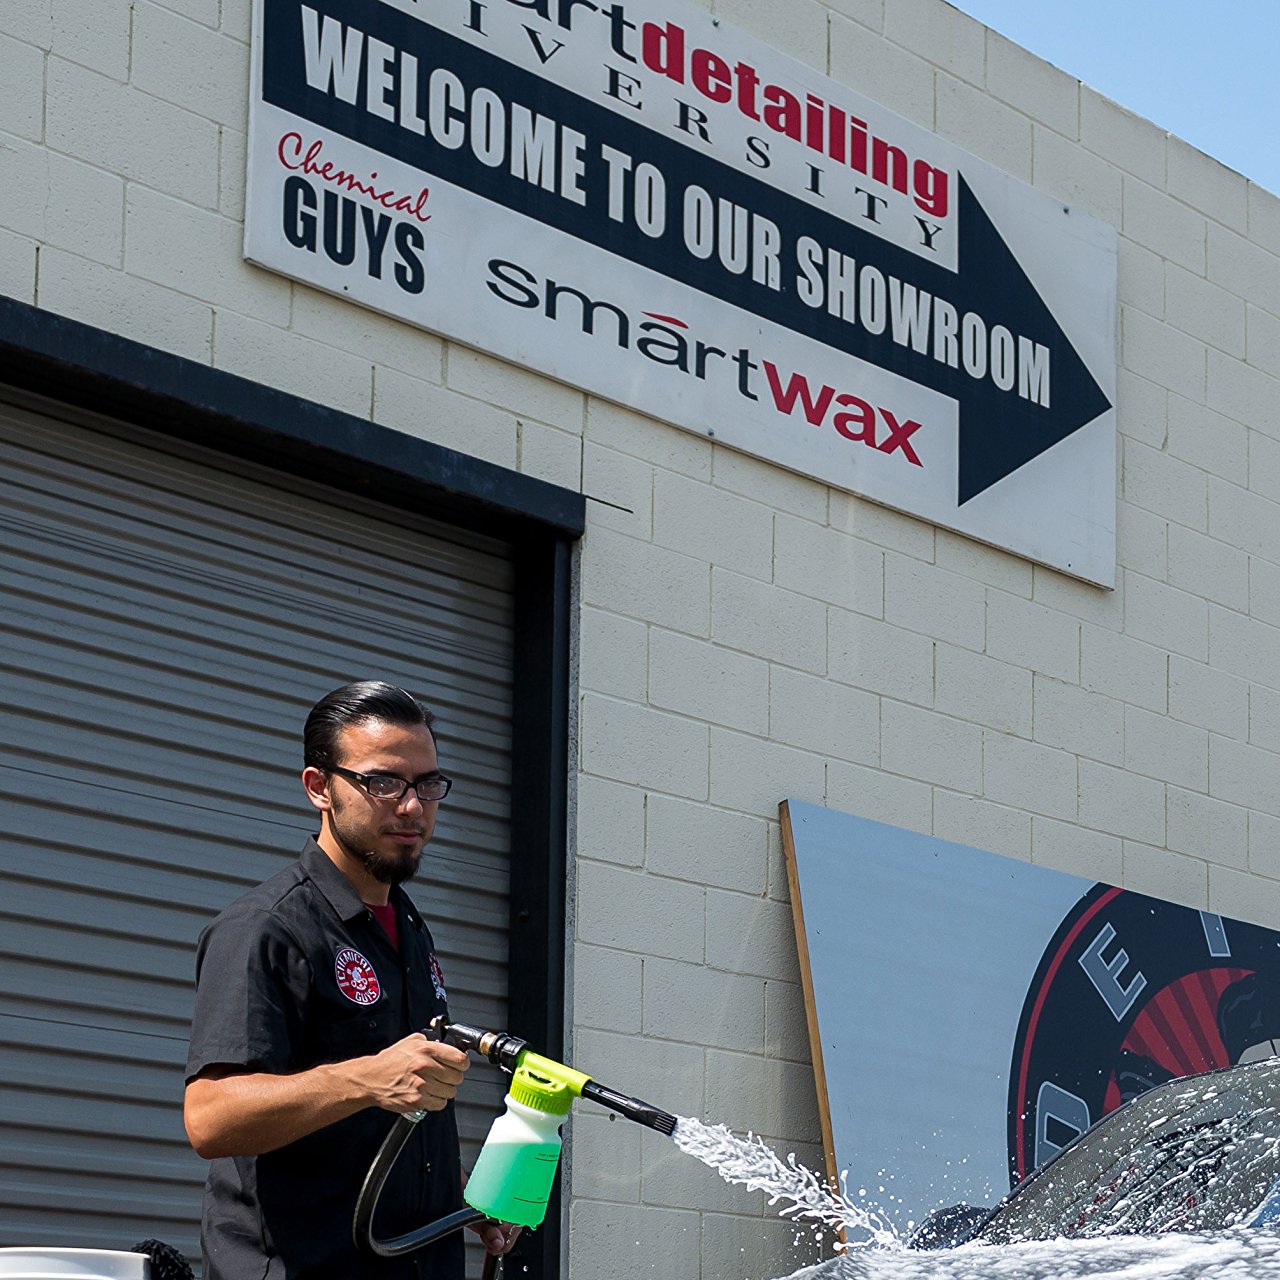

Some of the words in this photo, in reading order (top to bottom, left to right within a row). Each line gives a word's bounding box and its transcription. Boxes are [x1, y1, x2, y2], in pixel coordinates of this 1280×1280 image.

[278, 131, 432, 222] Chemical
[410, 0, 943, 253] IVERSITY
[283, 174, 425, 295] GUYS
[301, 4, 587, 207] WELCOME
[601, 143, 666, 239] TO
[683, 184, 782, 290] OUR
[796, 236, 1051, 409] SHOWROOM
[336, 951, 373, 981] CHEMICAL
[355, 988, 378, 1003] GUYS
